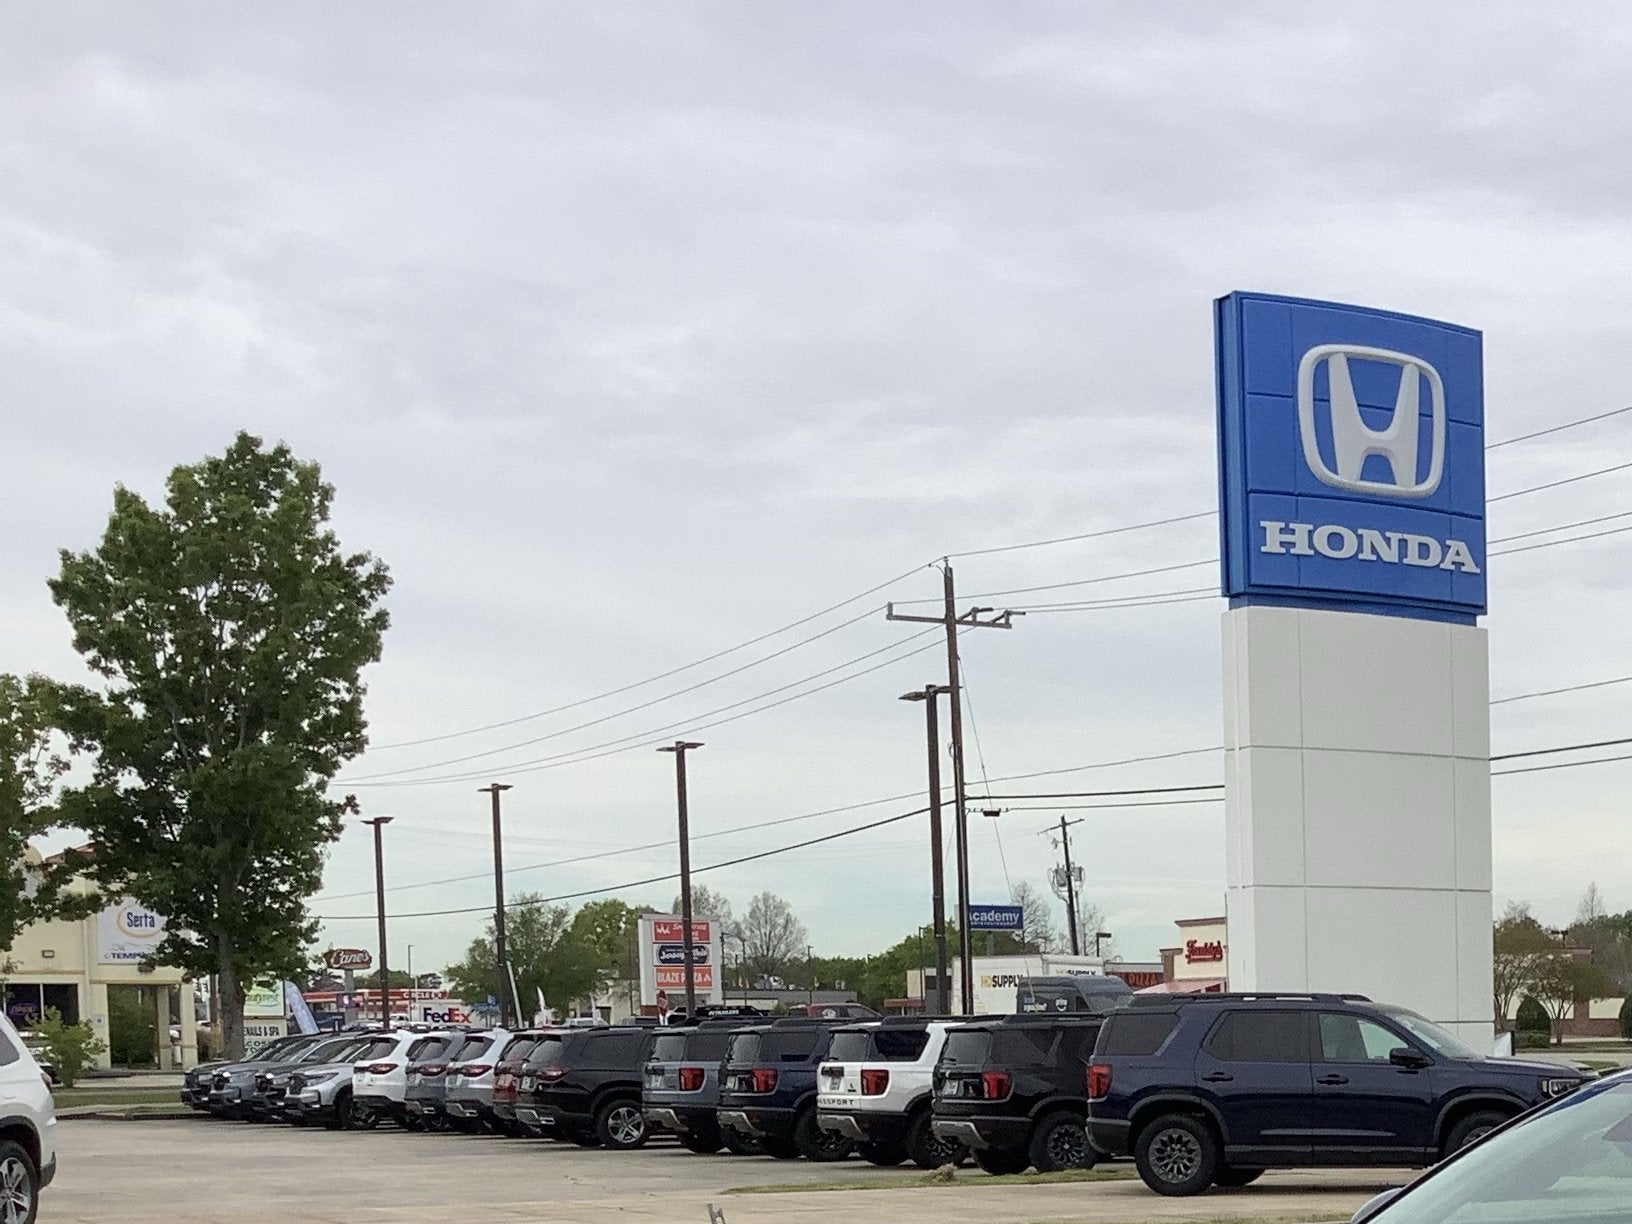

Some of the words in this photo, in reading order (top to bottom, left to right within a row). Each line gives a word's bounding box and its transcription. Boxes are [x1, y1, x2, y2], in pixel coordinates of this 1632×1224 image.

[1259, 520, 1480, 574] HONDA
[126, 911, 156, 928] Serta
[331, 950, 370, 968] Cane's
[423, 1007, 472, 1023] FedEx
